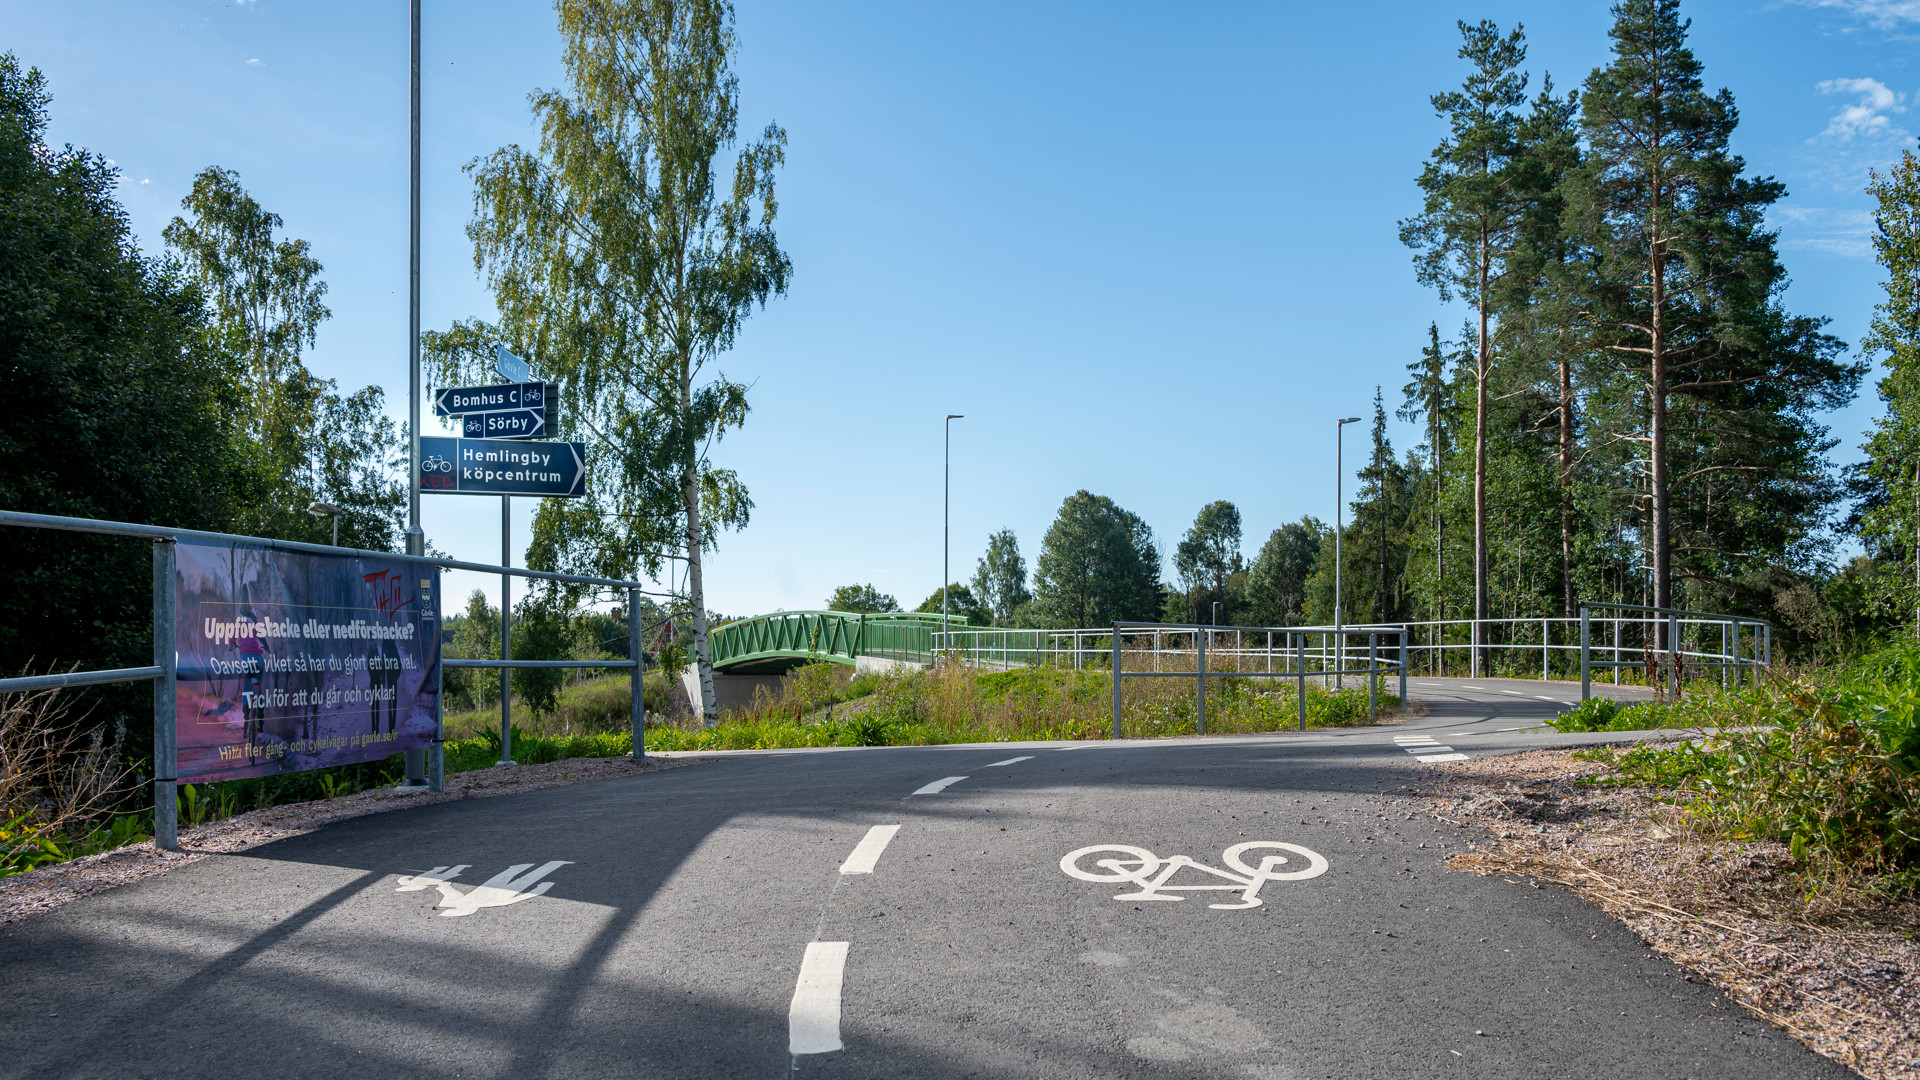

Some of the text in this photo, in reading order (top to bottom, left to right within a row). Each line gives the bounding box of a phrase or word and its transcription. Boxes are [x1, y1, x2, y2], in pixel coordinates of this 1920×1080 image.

[453, 390, 517, 407] Bomhus C
[488, 417, 528, 430] Sörby
[463, 448, 550, 467] Hemlingby
[463, 467, 561, 483] köpcentrum
[302, 618, 331, 639] eller
[332, 619, 415, 640] nedförsbacke?
[210, 656, 260, 675] Oavsett
[294, 652, 307, 672] så
[308, 653, 326, 672] har
[329, 653, 342, 671] du
[344, 653, 367, 675] gjort
[369, 655, 382, 670] ett
[383, 653, 399, 670] bra
[400, 653, 416, 670] val.
[292, 689, 307, 706] att
[311, 686, 323, 705] du
[325, 684, 341, 708] går
[344, 685, 362, 702] och
[364, 684, 395, 705] cyklar!
[218, 745, 242, 760] Hitta
[244, 743, 263, 758] fler
[265, 739, 287, 759] gång-
[290, 738, 306, 752] och
[308, 734, 348, 754] cykelvägar
[350, 731, 360, 749] på
